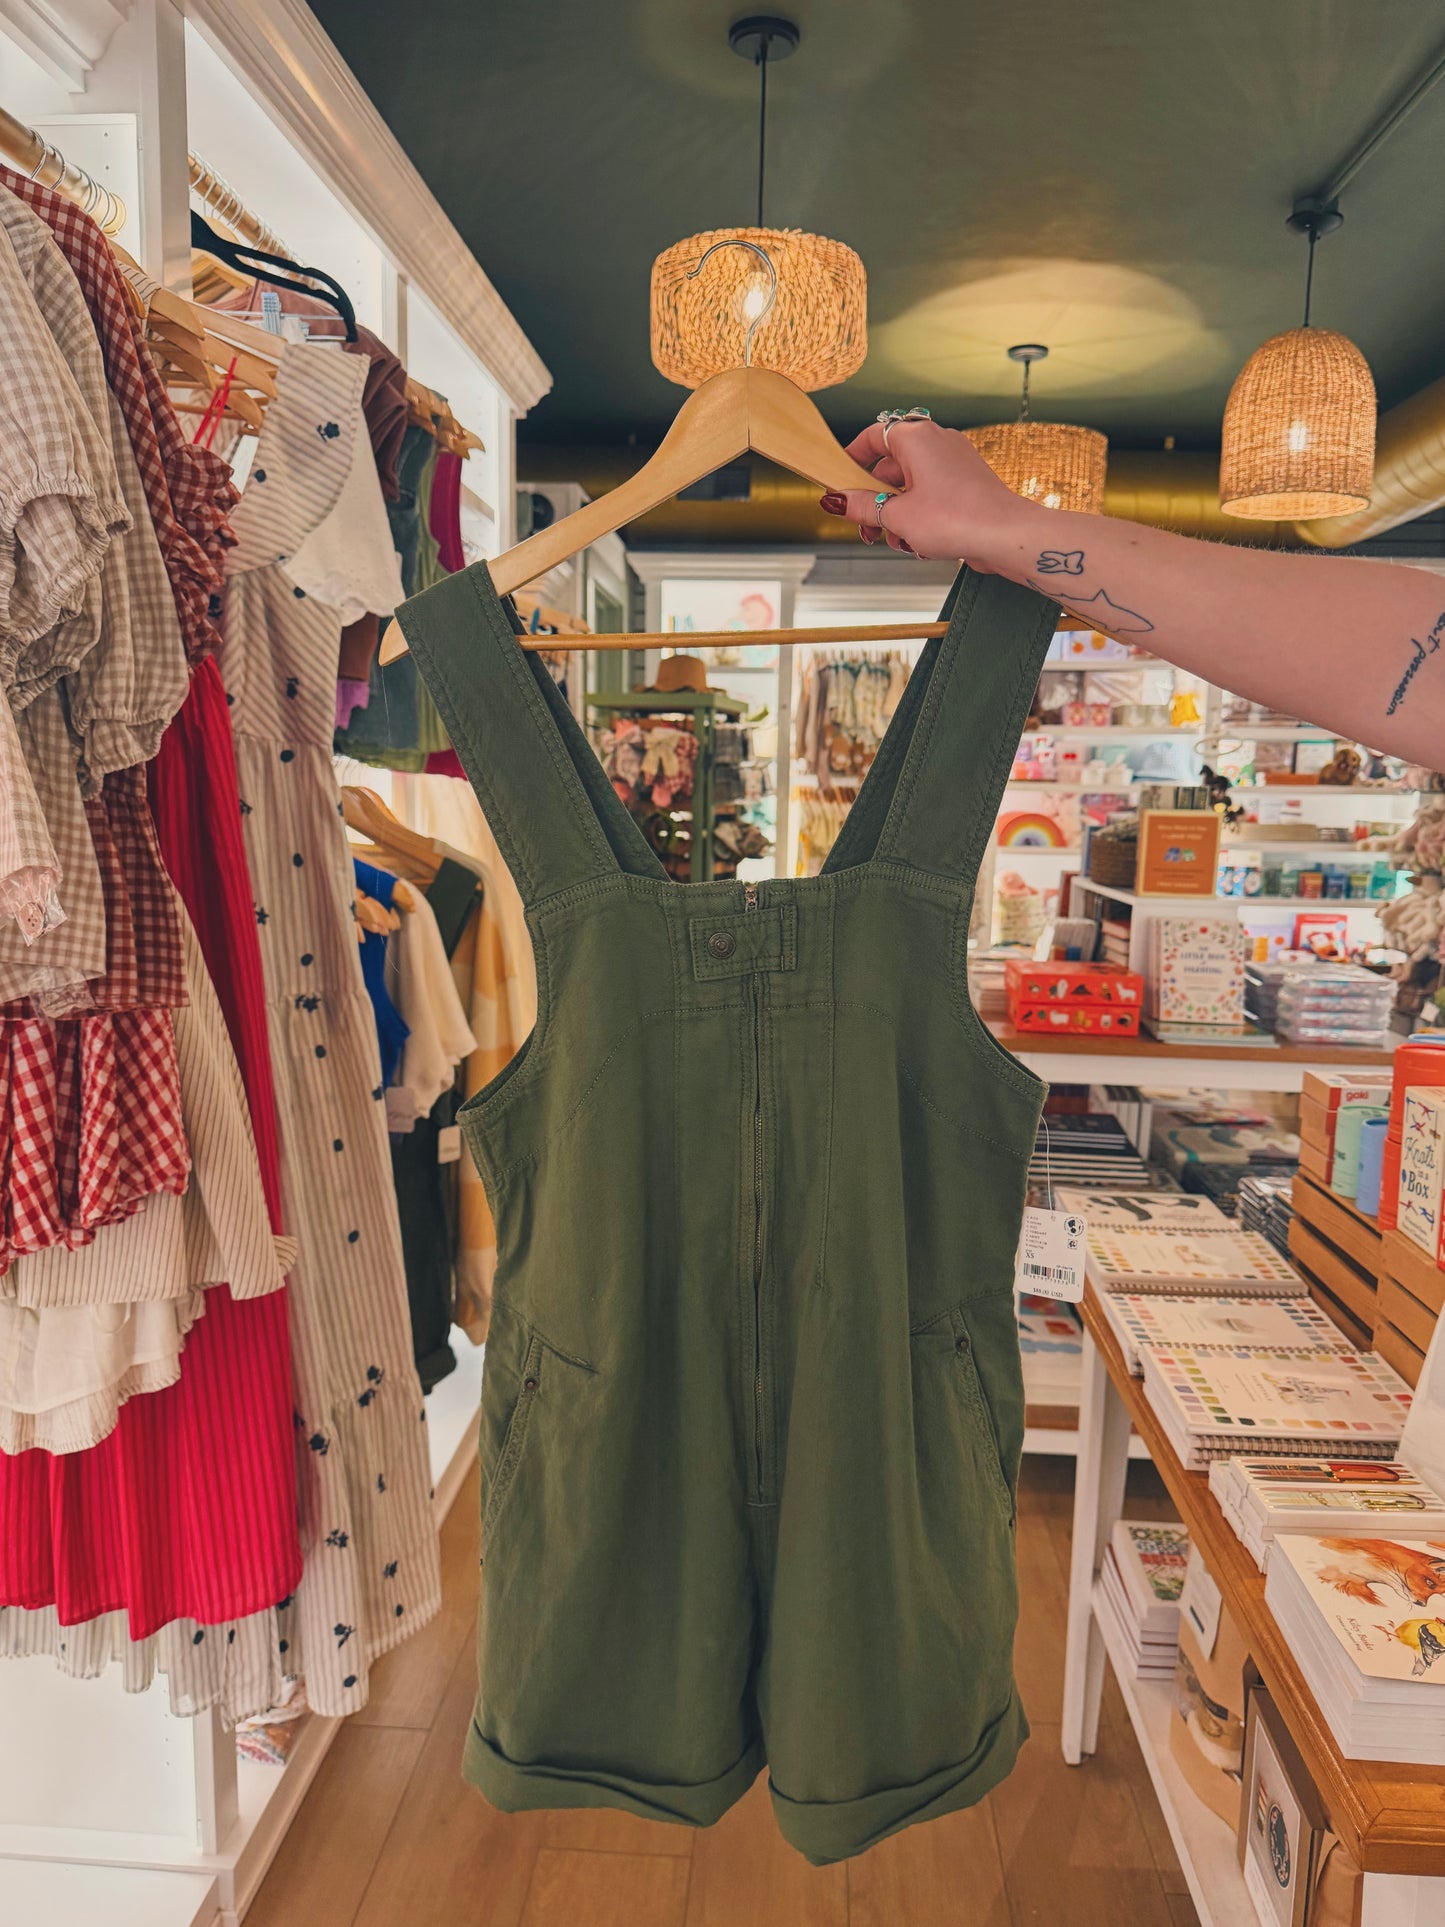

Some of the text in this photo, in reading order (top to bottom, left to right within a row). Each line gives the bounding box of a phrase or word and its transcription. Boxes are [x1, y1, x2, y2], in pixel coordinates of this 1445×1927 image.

[1404, 1136, 1435, 1169] Knots
[1407, 1170, 1430, 1199] Box
[1025, 1251, 1035, 1259] XS
